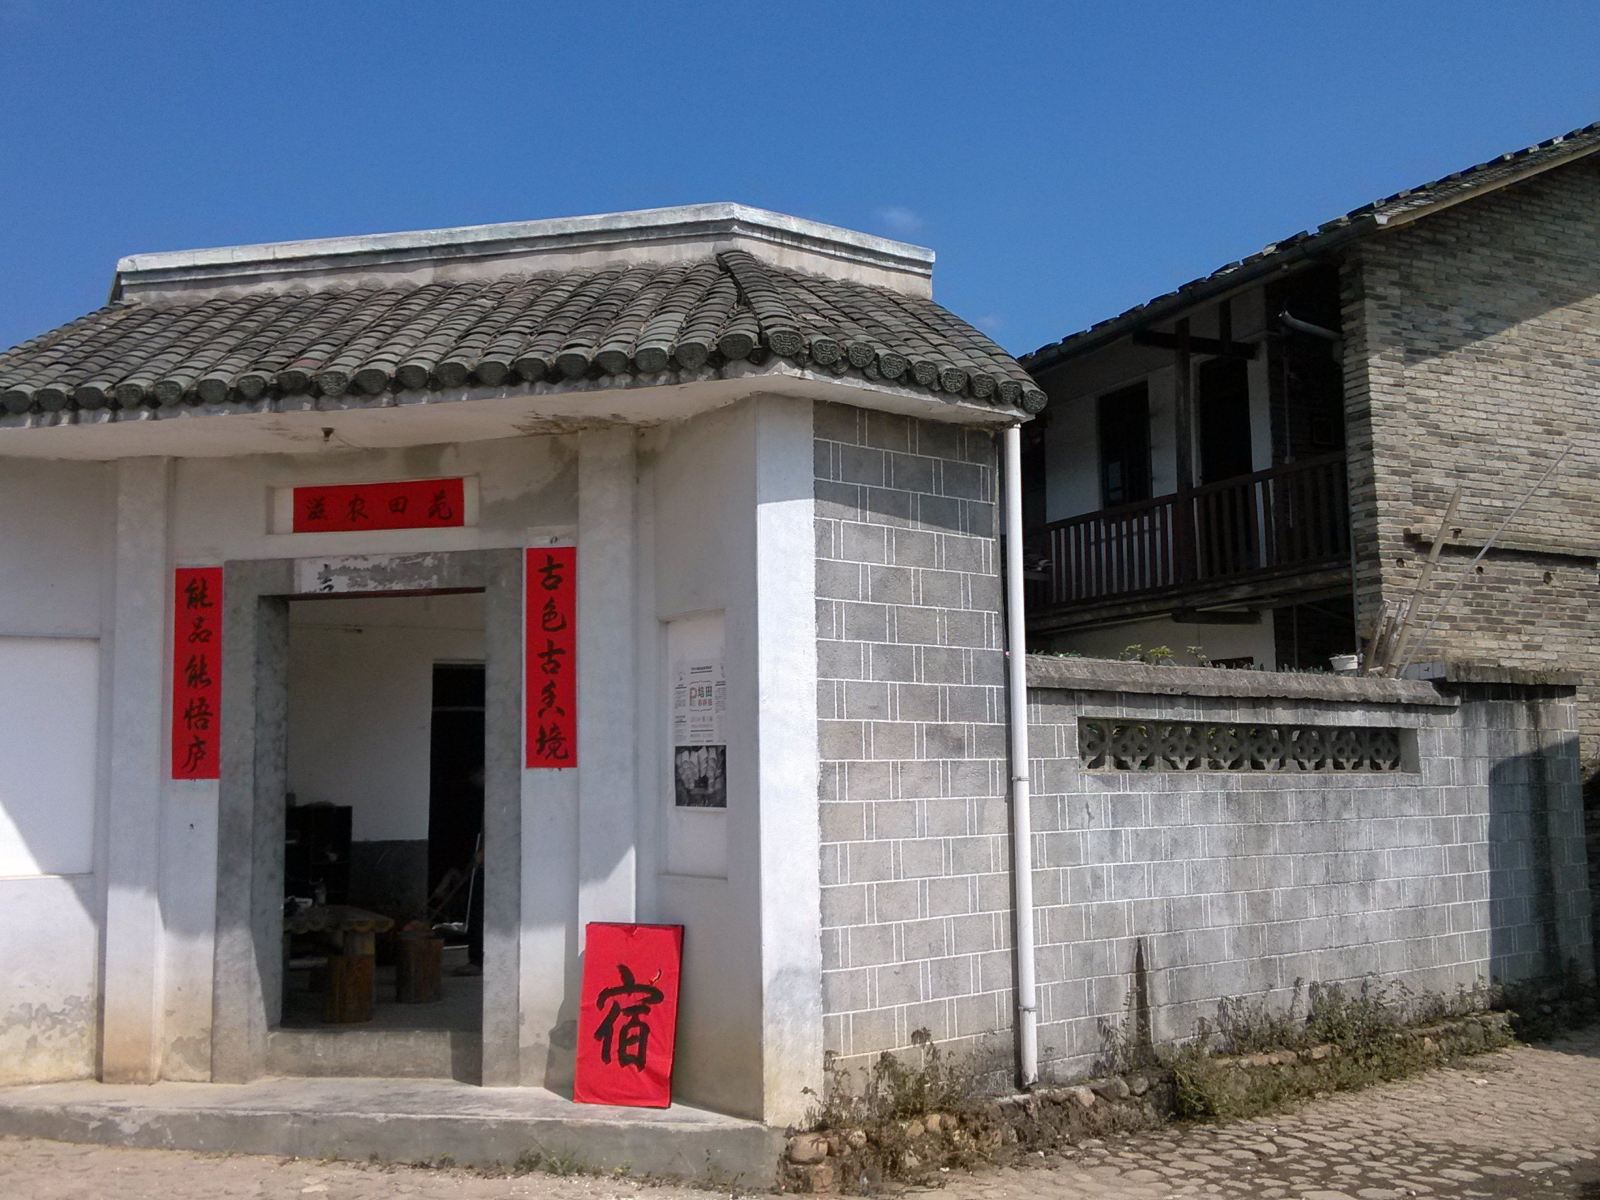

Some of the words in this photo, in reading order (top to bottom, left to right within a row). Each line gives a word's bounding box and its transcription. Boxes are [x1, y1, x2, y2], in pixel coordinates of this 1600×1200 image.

[535, 555, 569, 761] 古色古香境
[594, 964, 665, 1072] 宿
